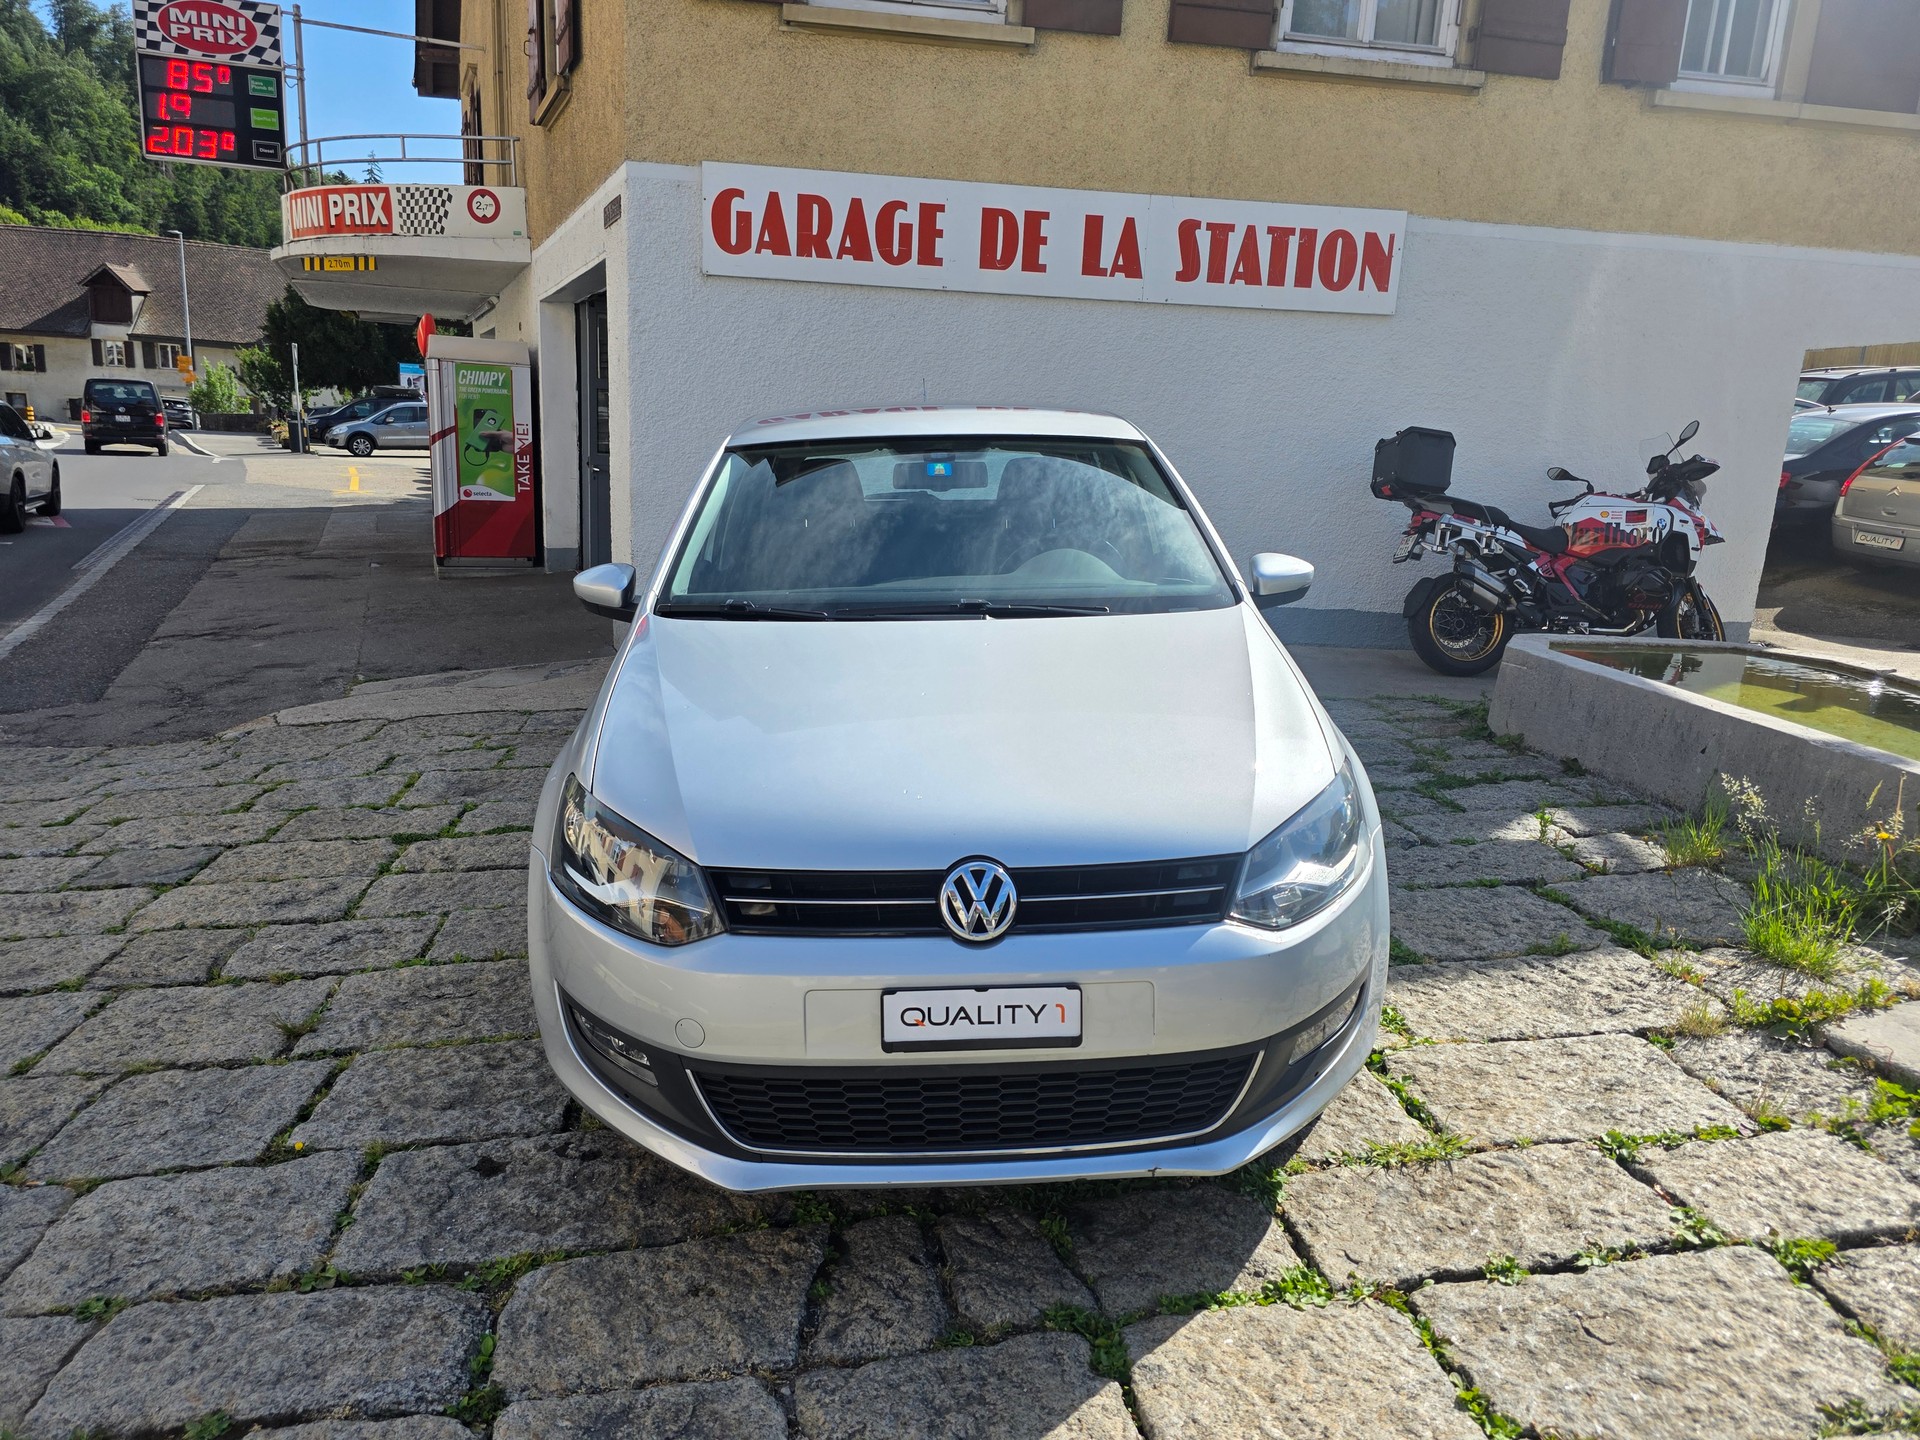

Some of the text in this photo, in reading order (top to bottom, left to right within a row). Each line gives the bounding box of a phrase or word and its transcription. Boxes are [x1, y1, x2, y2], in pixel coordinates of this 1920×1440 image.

[168, 7, 247, 31] MINI
[169, 23, 249, 47] PRIX
[292, 192, 389, 230] MINI PRIX
[710, 187, 1396, 293] GARAGE DE LA STATION
[458, 369, 506, 386] CHIMPY
[515, 423, 531, 493] TAKE ME!
[1859, 534, 1896, 545] QUALITY
[900, 1003, 1066, 1027] QUALITY 1
